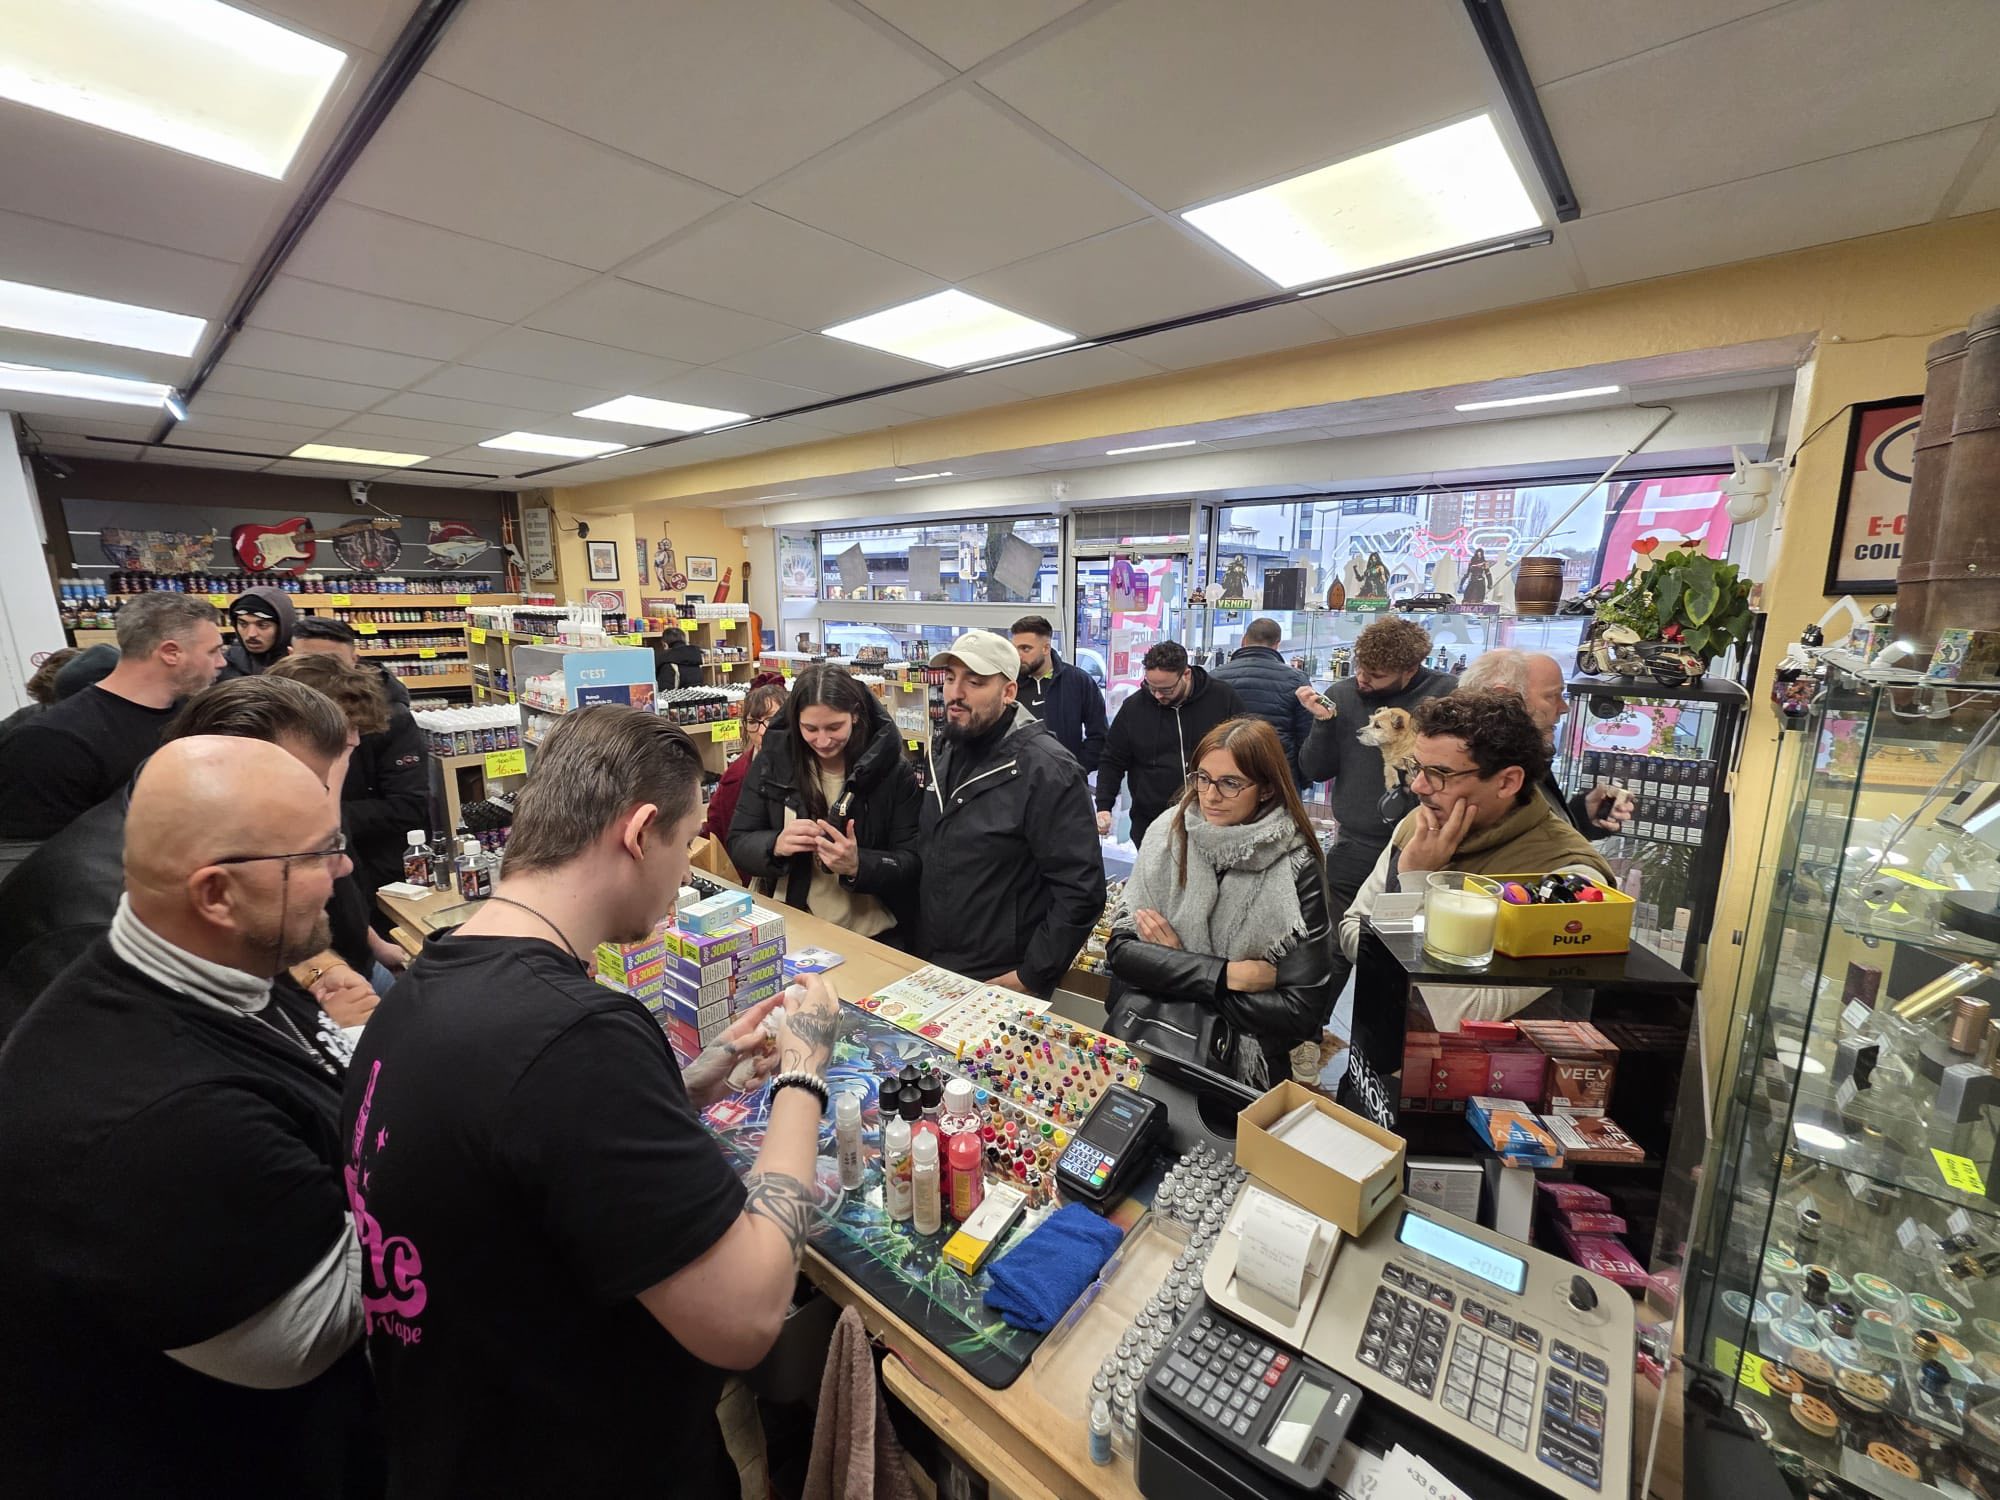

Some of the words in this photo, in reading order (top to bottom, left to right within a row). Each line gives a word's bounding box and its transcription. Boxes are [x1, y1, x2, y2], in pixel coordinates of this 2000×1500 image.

[532, 560, 553, 579] SOLDES
[579, 668, 607, 680] C'EST
[1552, 934, 1592, 946] PULP
[1560, 1067, 1611, 1081] VEEV
[1349, 1054, 1390, 1131] SMOK
[1585, 1081, 1608, 1089] one
[1497, 1129, 1553, 1143] VEEV
[1597, 1117, 1640, 1151] VEEV
[1589, 1259, 1648, 1275] VEEV
[377, 1314, 422, 1346] Vape
[1334, 1393, 1350, 1417] Canon
